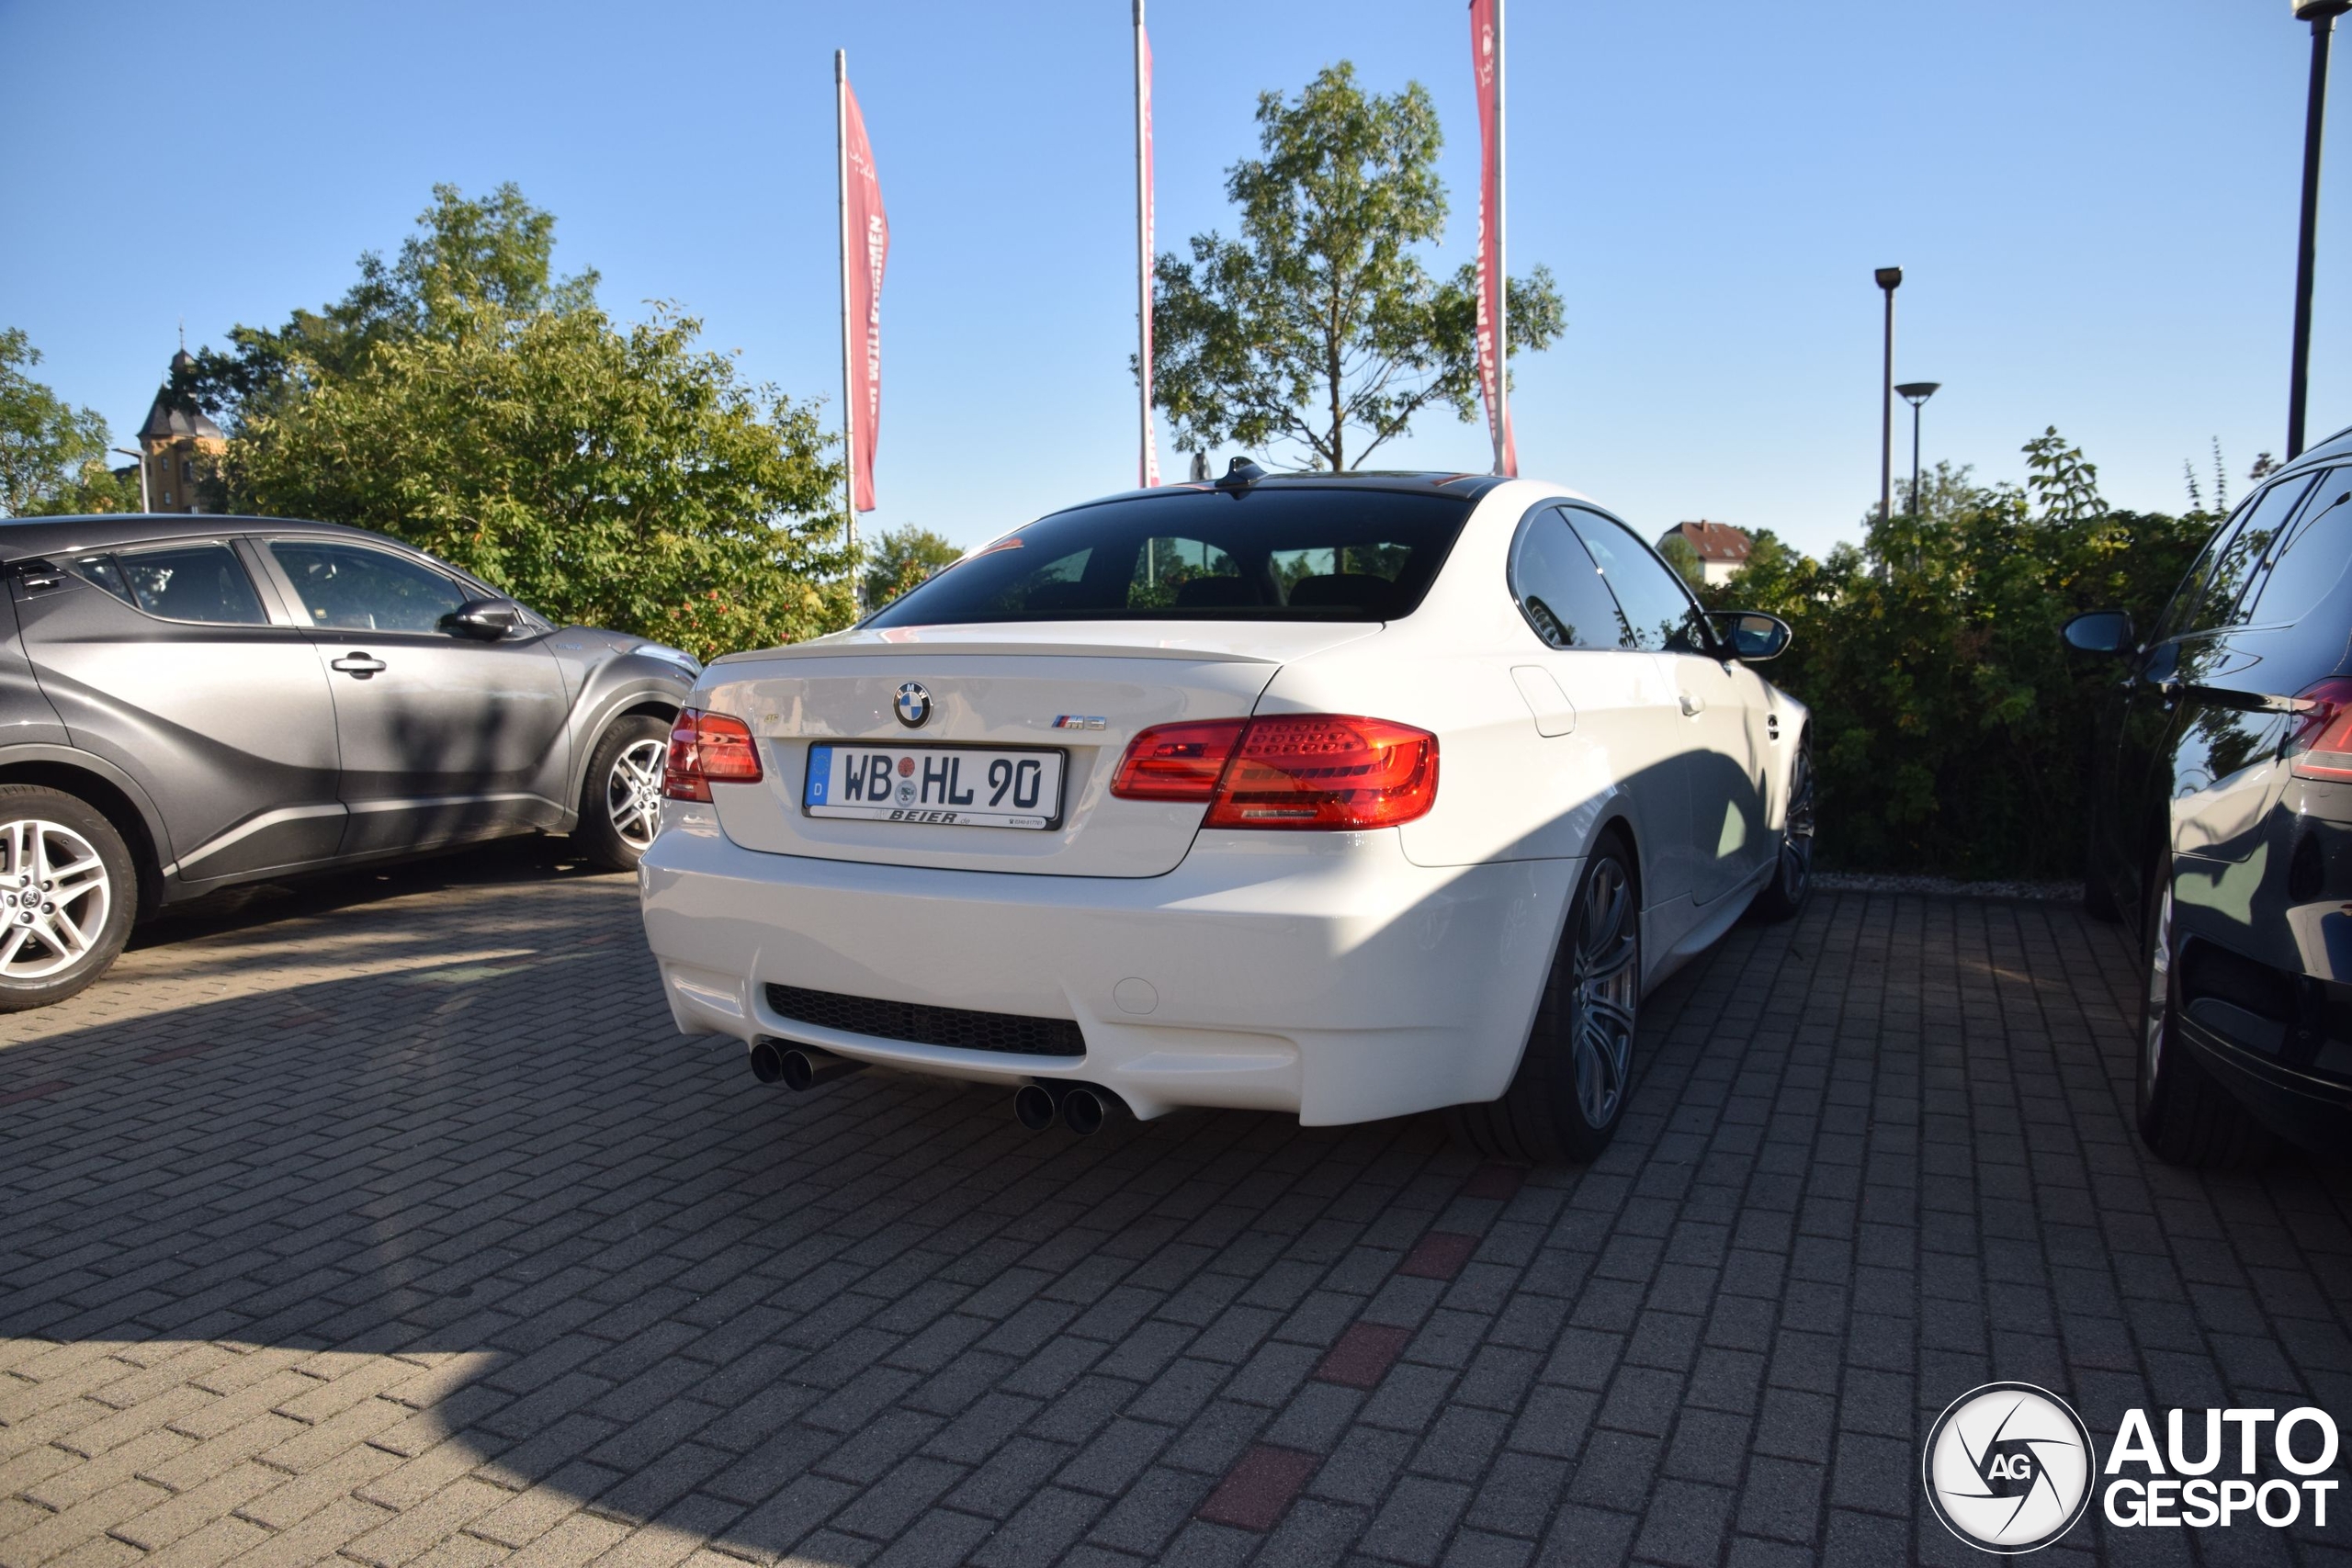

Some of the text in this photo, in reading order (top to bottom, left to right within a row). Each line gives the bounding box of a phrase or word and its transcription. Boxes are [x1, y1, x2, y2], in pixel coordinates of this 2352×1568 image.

[896, 683, 928, 700] BMW
[844, 754, 1042, 808] WB HL 90
[813, 783, 822, 796] D
[888, 810, 957, 824] BEIER
